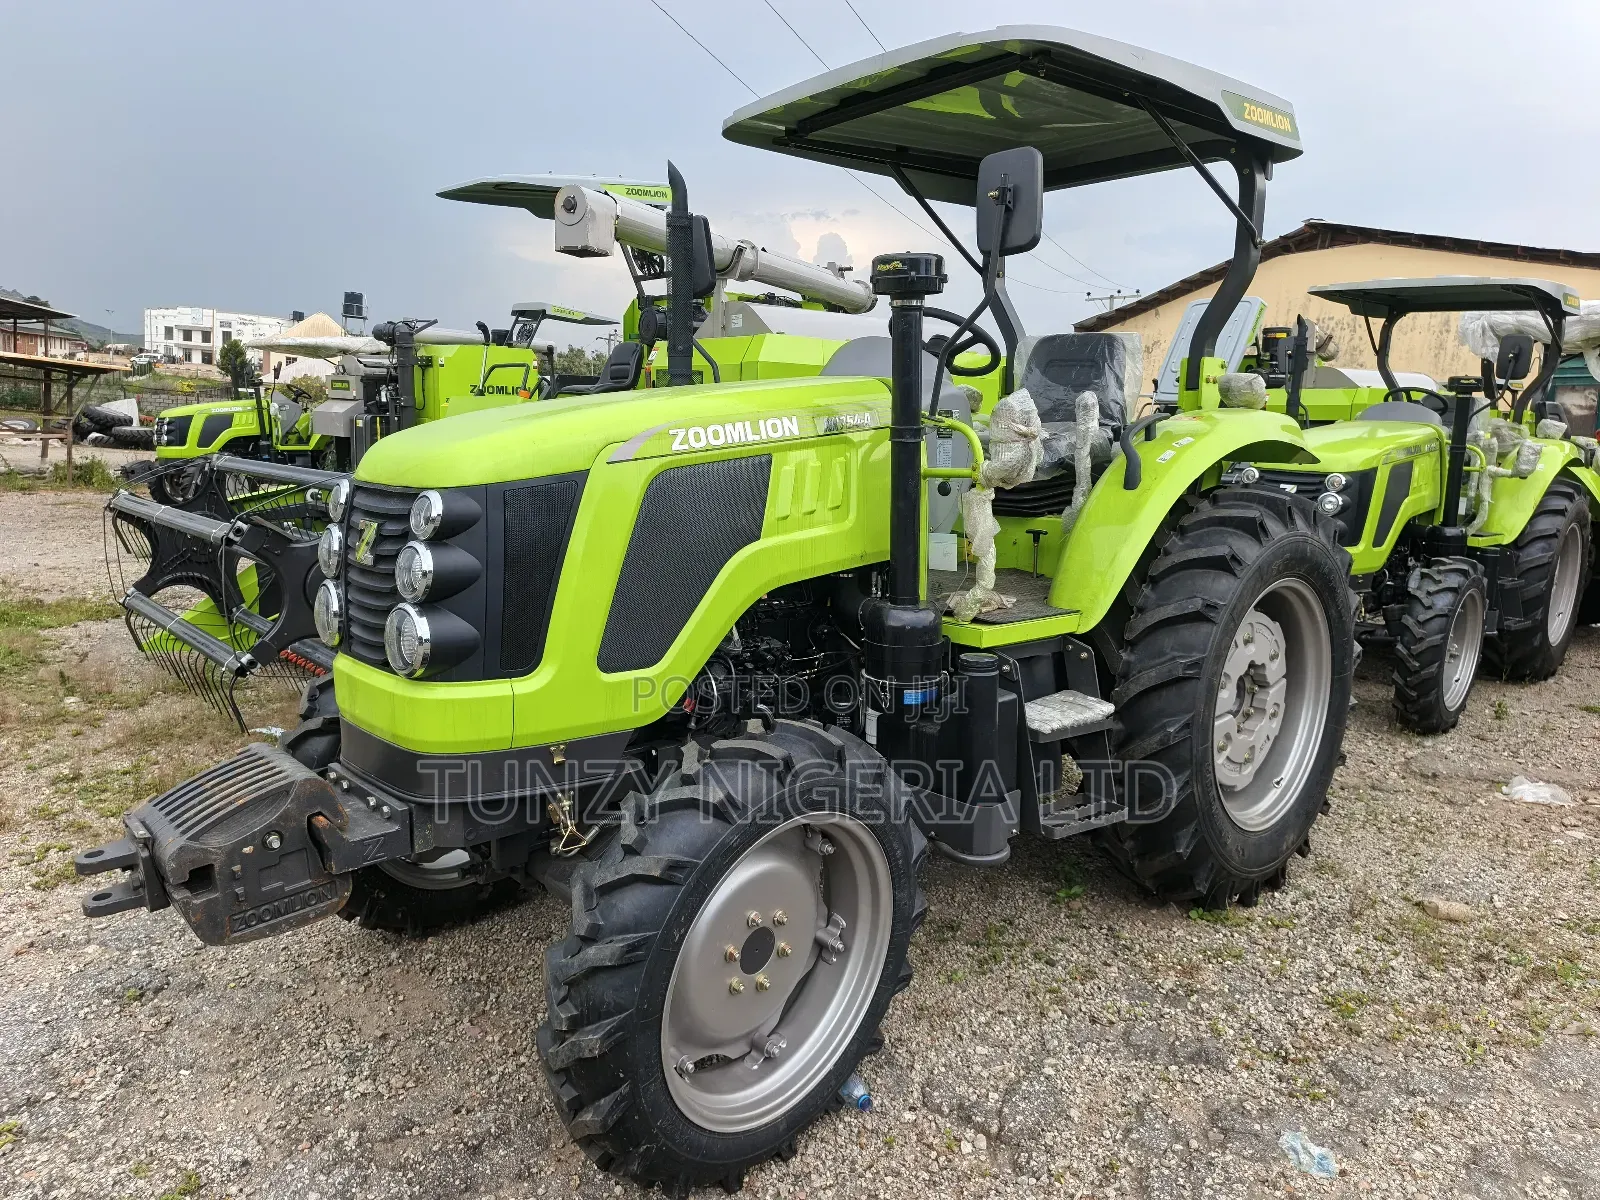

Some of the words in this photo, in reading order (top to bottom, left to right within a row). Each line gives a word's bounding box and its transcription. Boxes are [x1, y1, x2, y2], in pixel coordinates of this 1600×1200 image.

[1243, 102, 1292, 132] ZOOMLION
[625, 187, 668, 198] ZOOMLION
[669, 415, 800, 451] ZOOMLION
[232, 883, 335, 932] ZOOMLION
